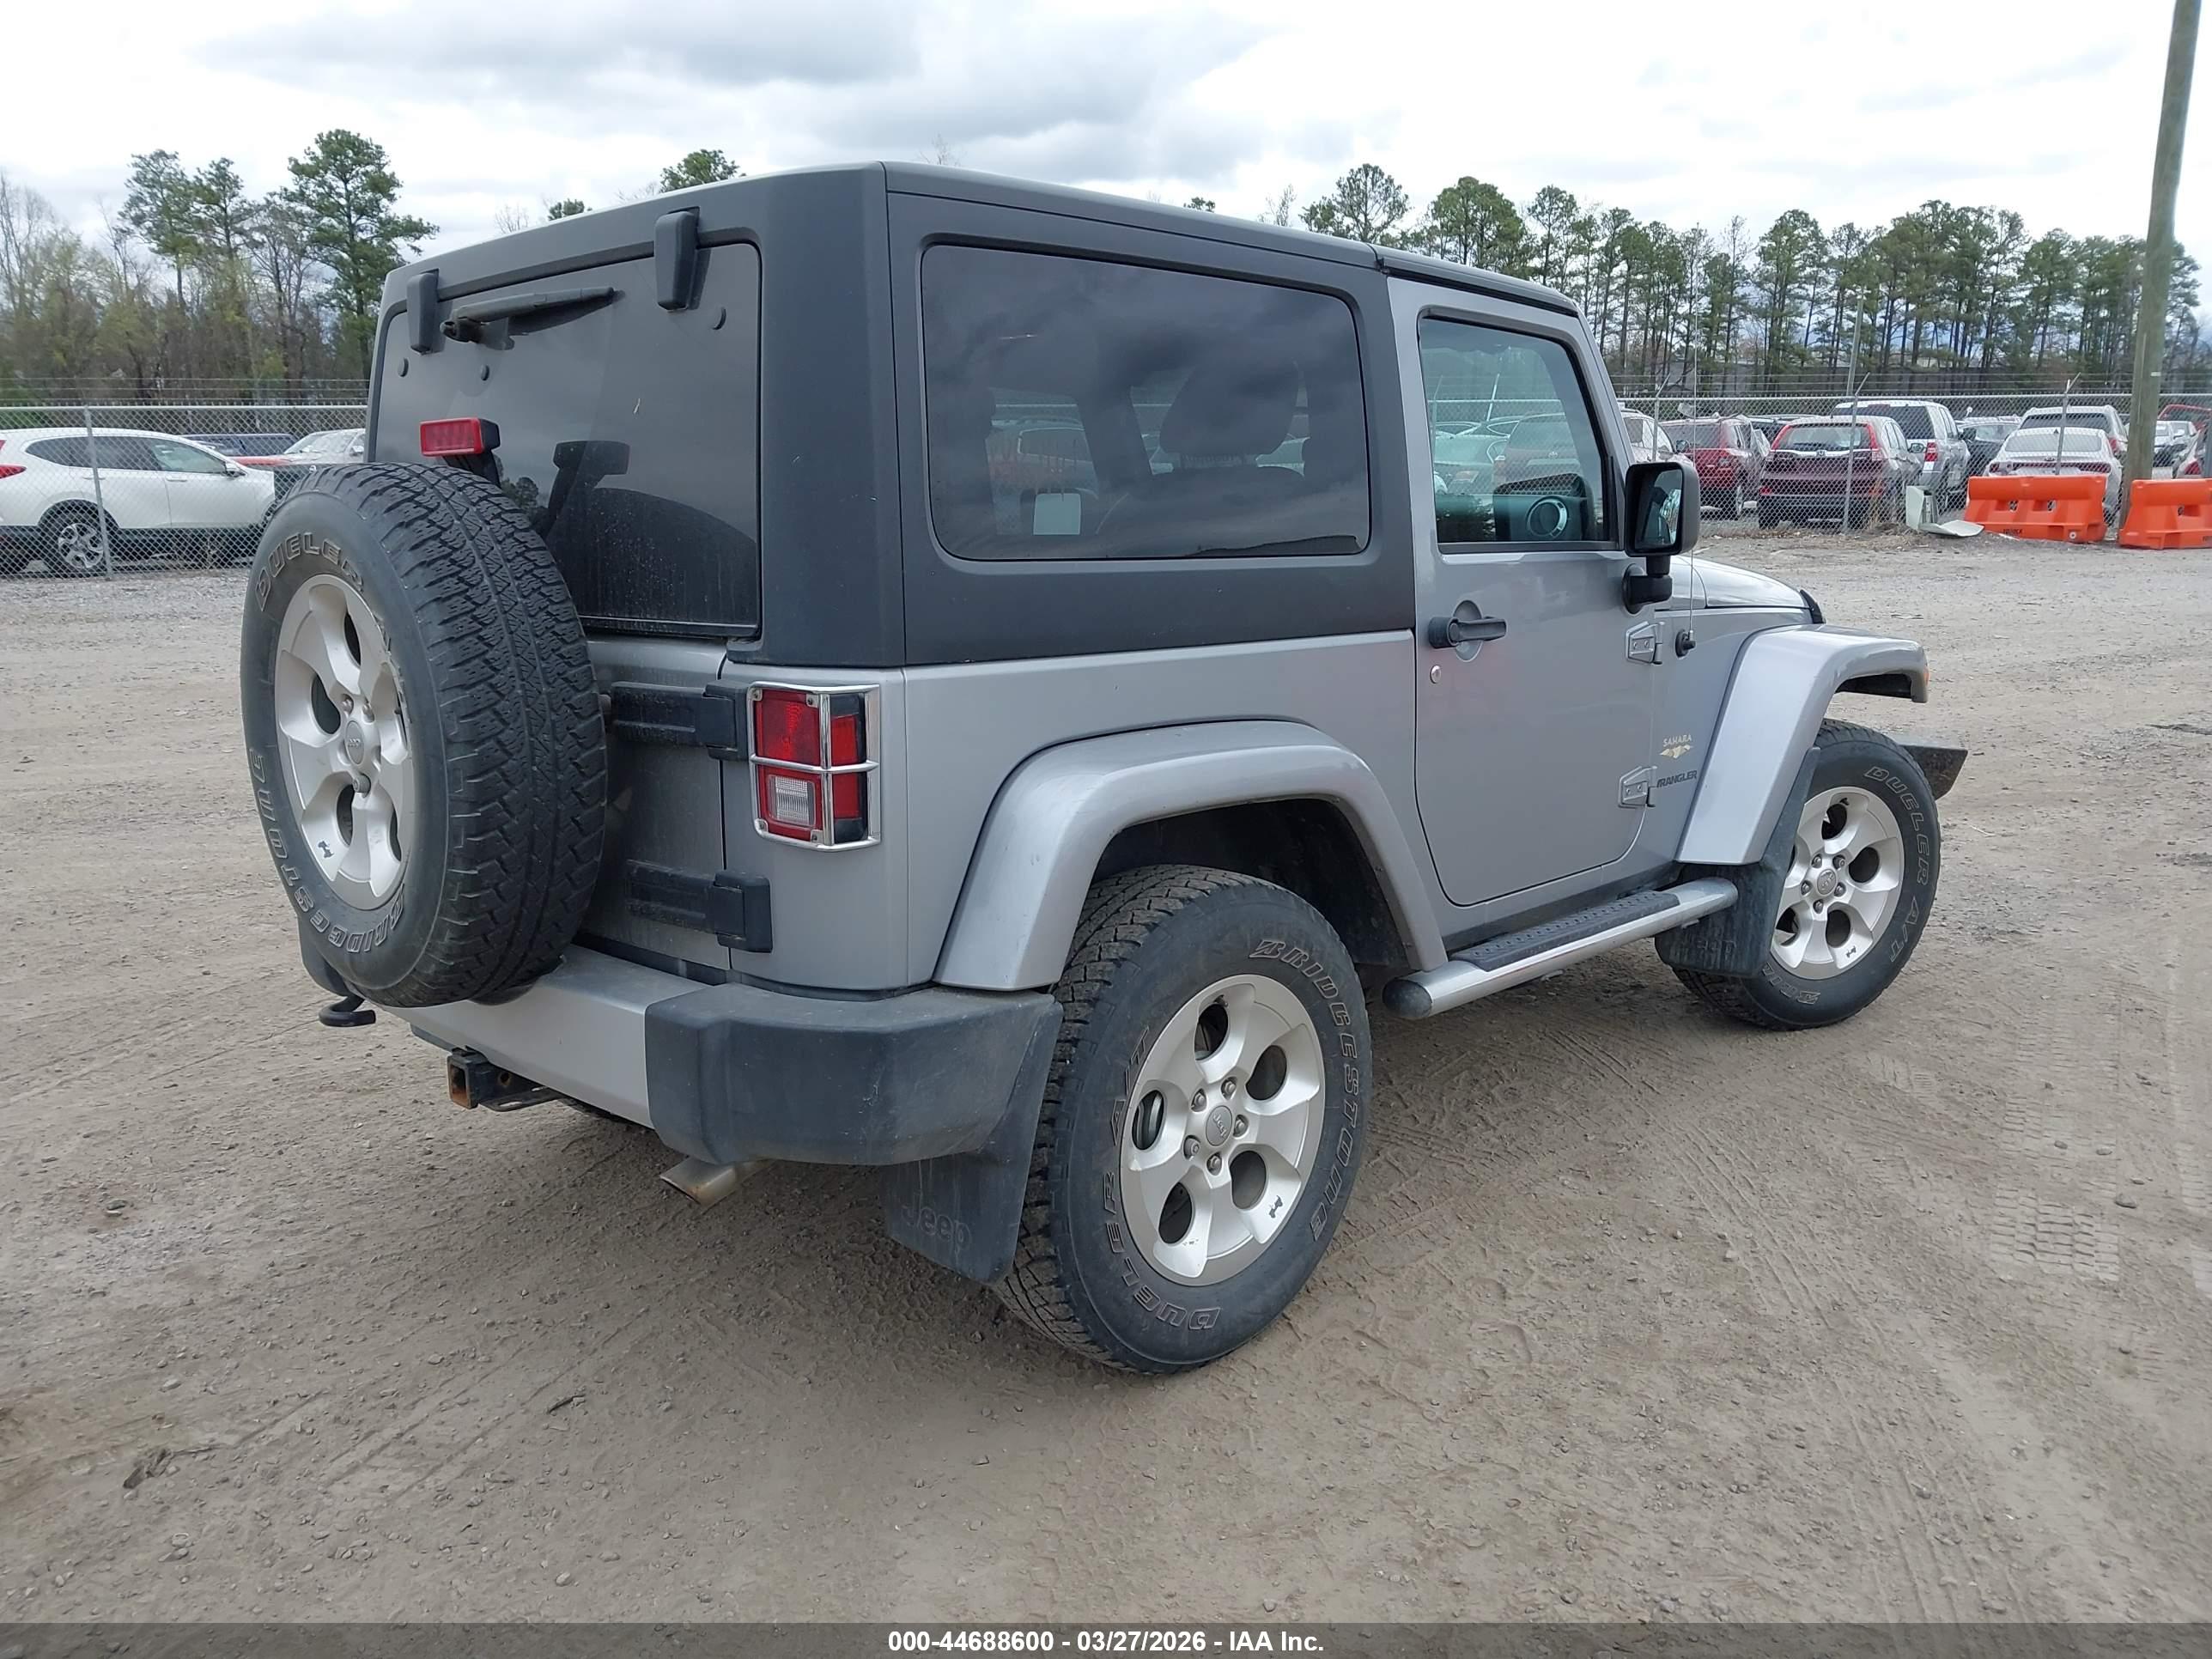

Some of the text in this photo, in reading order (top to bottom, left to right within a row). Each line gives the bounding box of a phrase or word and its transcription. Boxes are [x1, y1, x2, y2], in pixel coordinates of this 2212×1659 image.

[255, 532, 364, 612] DUELER
[1662, 733, 1692, 747] SAHARA
[249, 748, 406, 954] BRIDGESTONE
[1863, 766, 1930, 963] DUELER A/T
[1212, 1114, 1228, 1139] Jeep
[1249, 939, 1359, 1243] BRIDGESTONE
[1103, 1170, 1221, 1330] DUELER
